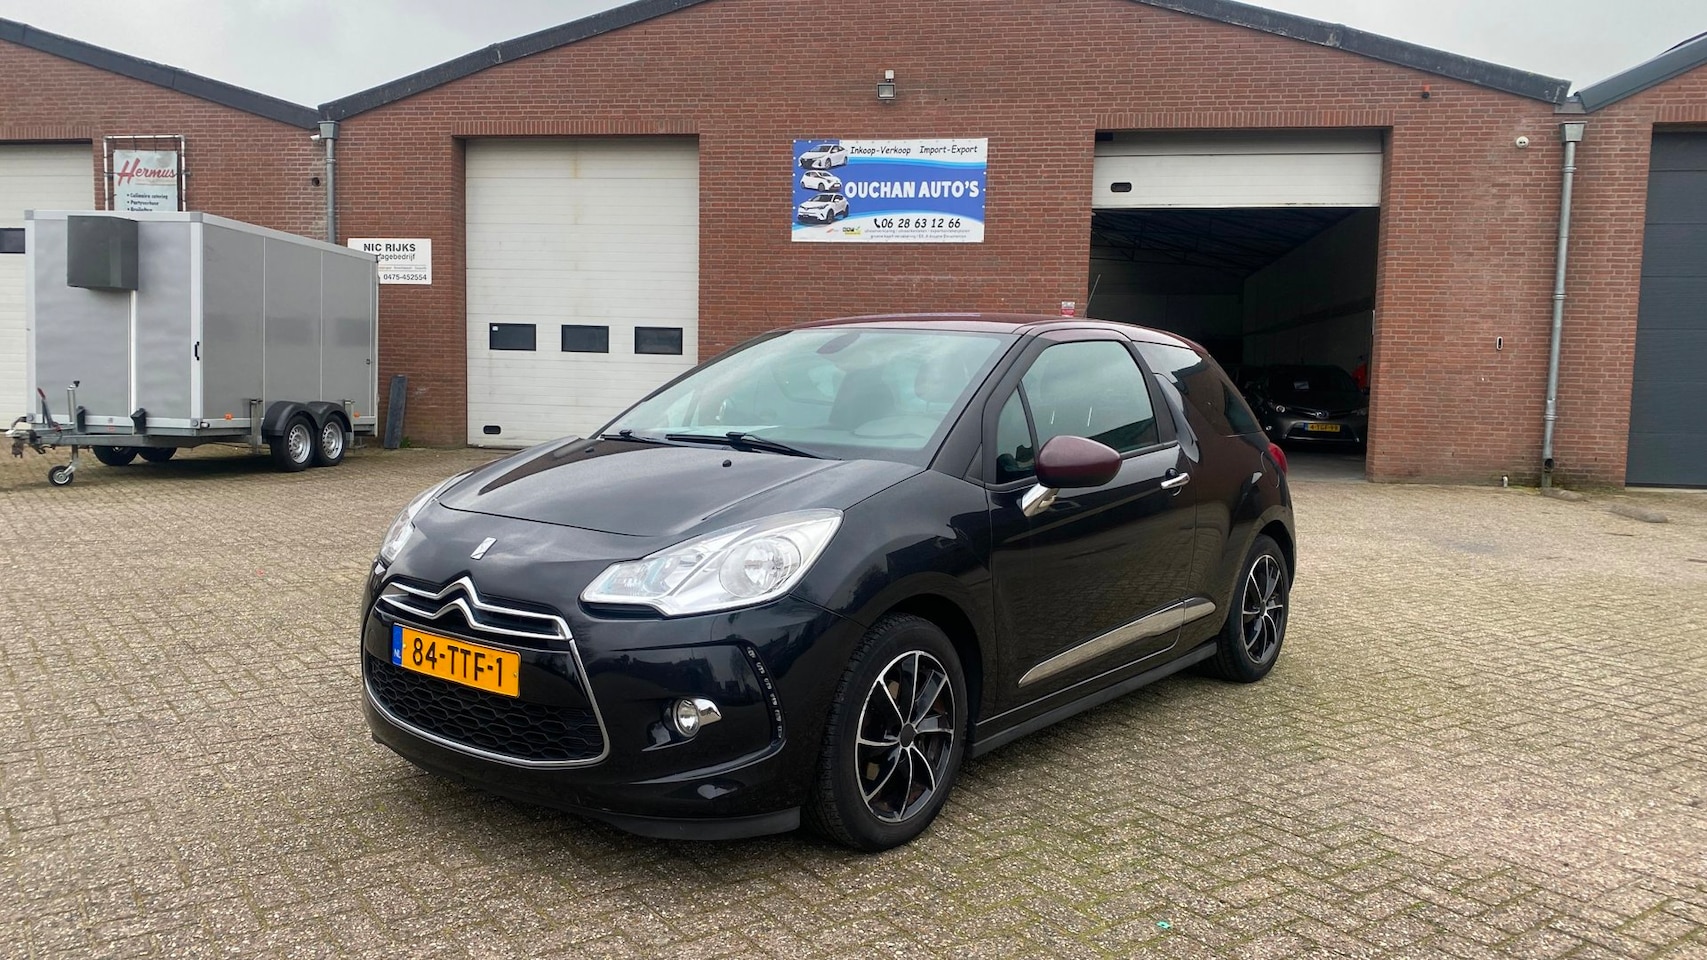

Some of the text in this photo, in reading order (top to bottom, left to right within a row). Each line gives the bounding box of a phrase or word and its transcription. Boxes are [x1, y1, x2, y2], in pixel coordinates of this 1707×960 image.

[850, 145, 978, 156] Inkoop-Verkoop Import-Export
[118, 158, 177, 186] Hermus
[845, 180, 980, 198] OUCHAN AUTO'S
[881, 218, 961, 229] 06 28 63 12 66
[363, 243, 416, 252] NIC RIJKS
[378, 253, 415, 261] agebedrijf
[393, 649, 402, 659] NL
[412, 637, 502, 687] 84-TTF-1
